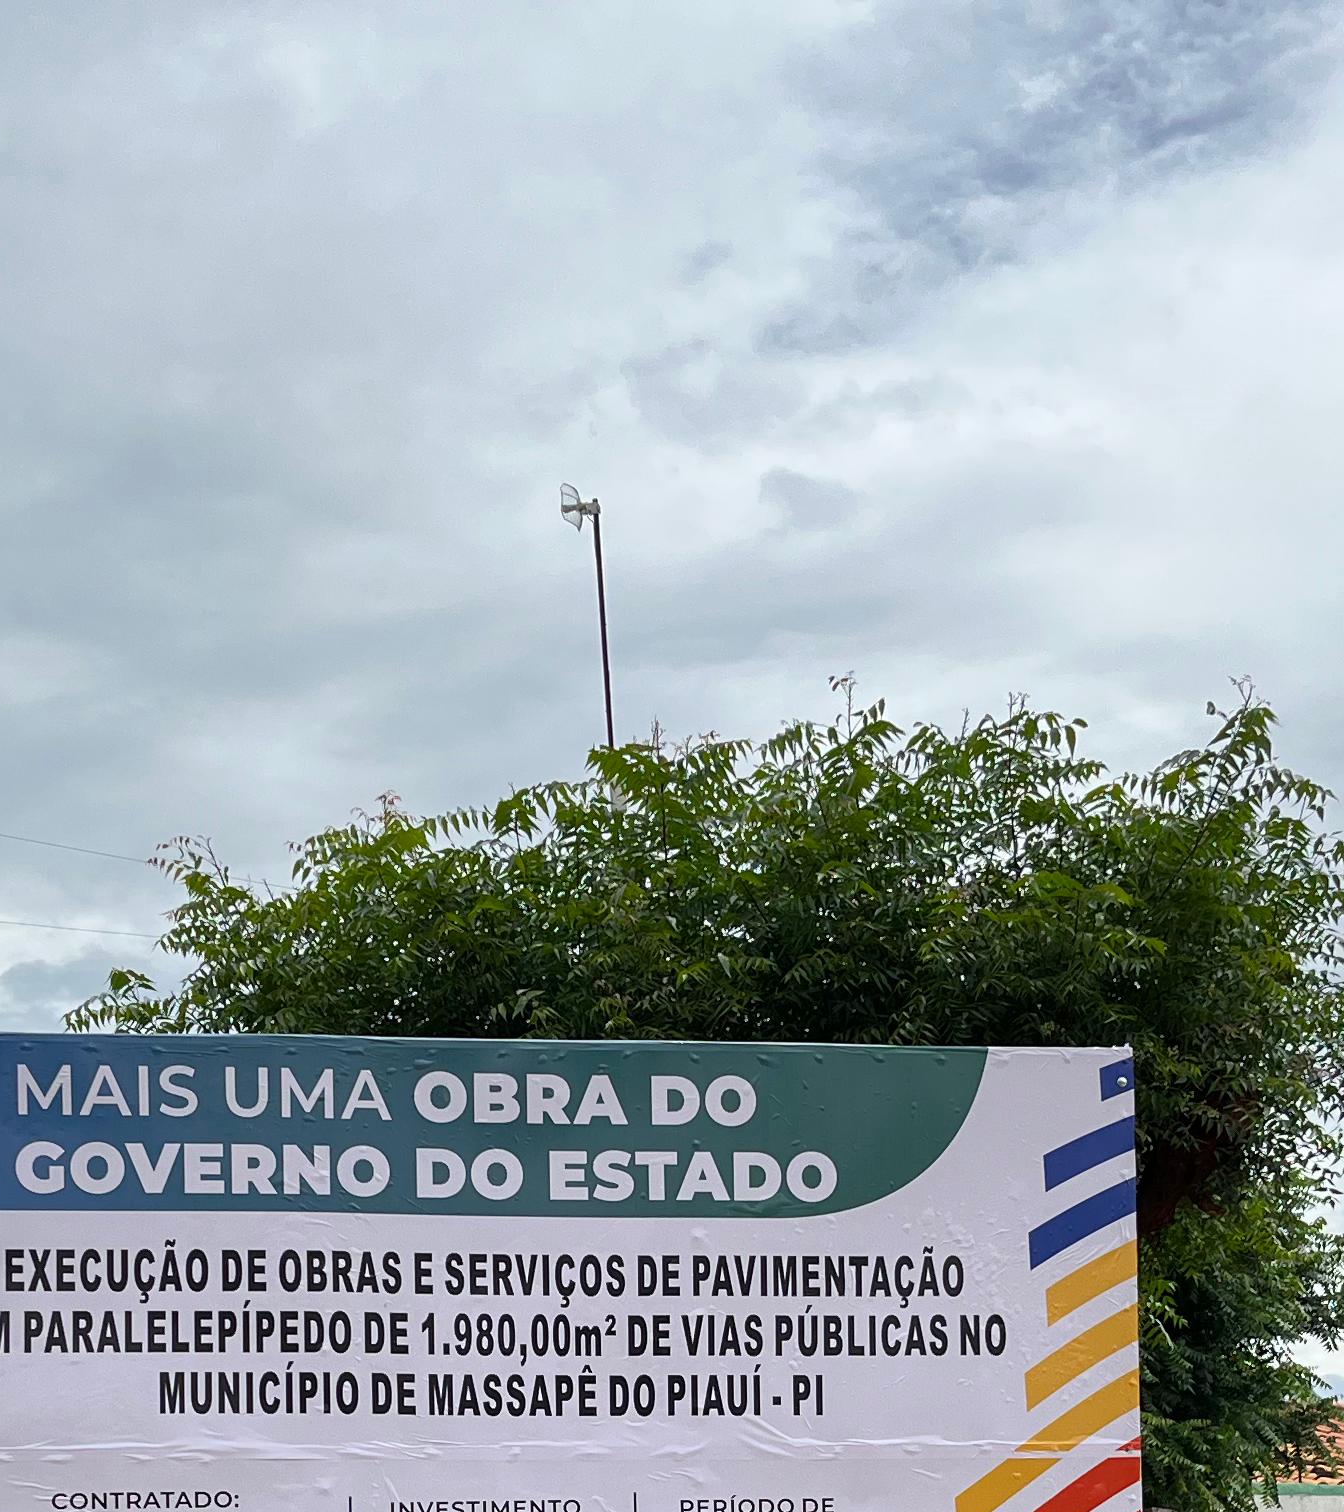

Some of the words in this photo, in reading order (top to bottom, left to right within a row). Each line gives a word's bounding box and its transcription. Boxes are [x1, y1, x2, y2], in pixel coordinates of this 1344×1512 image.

[17, 1063, 198, 1117] MAIS
[225, 1066, 393, 1121] UMA
[413, 1070, 629, 1125] OBRA
[650, 1074, 757, 1127] DO
[15, 1140, 391, 1198] GOVERNO
[415, 1147, 524, 1201] DO
[548, 1149, 838, 1203] ESTADO
[4, 1238, 209, 1304] EXECUÇÃO
[221, 1249, 267, 1292] DE
[278, 1248, 402, 1295] OBRAS
[413, 1252, 434, 1295] E
[444, 1252, 626, 1309] SERVIÇOS
[637, 1254, 681, 1297] DE
[692, 1245, 964, 1309] PAVIMENTAÇÃO
[23, 1300, 352, 1354] PARALELEPÍPEDO
[363, 1311, 409, 1355] DE
[421, 1312, 617, 1367] 1.980,00m²
[627, 1314, 671, 1357] DE
[680, 1314, 764, 1357] VIAS
[774, 1304, 949, 1357] PÚBLICAS
[959, 1313, 1007, 1357] NO
[159, 1360, 359, 1415] MUNICÍPIO
[371, 1372, 417, 1416] DE
[428, 1364, 598, 1417] MASSAPÊ
[609, 1374, 656, 1417] DO
[667, 1363, 762, 1417] PIAUÍ
[792, 1374, 824, 1416] PI
[51, 1490, 239, 1510] CONTRATADO:
